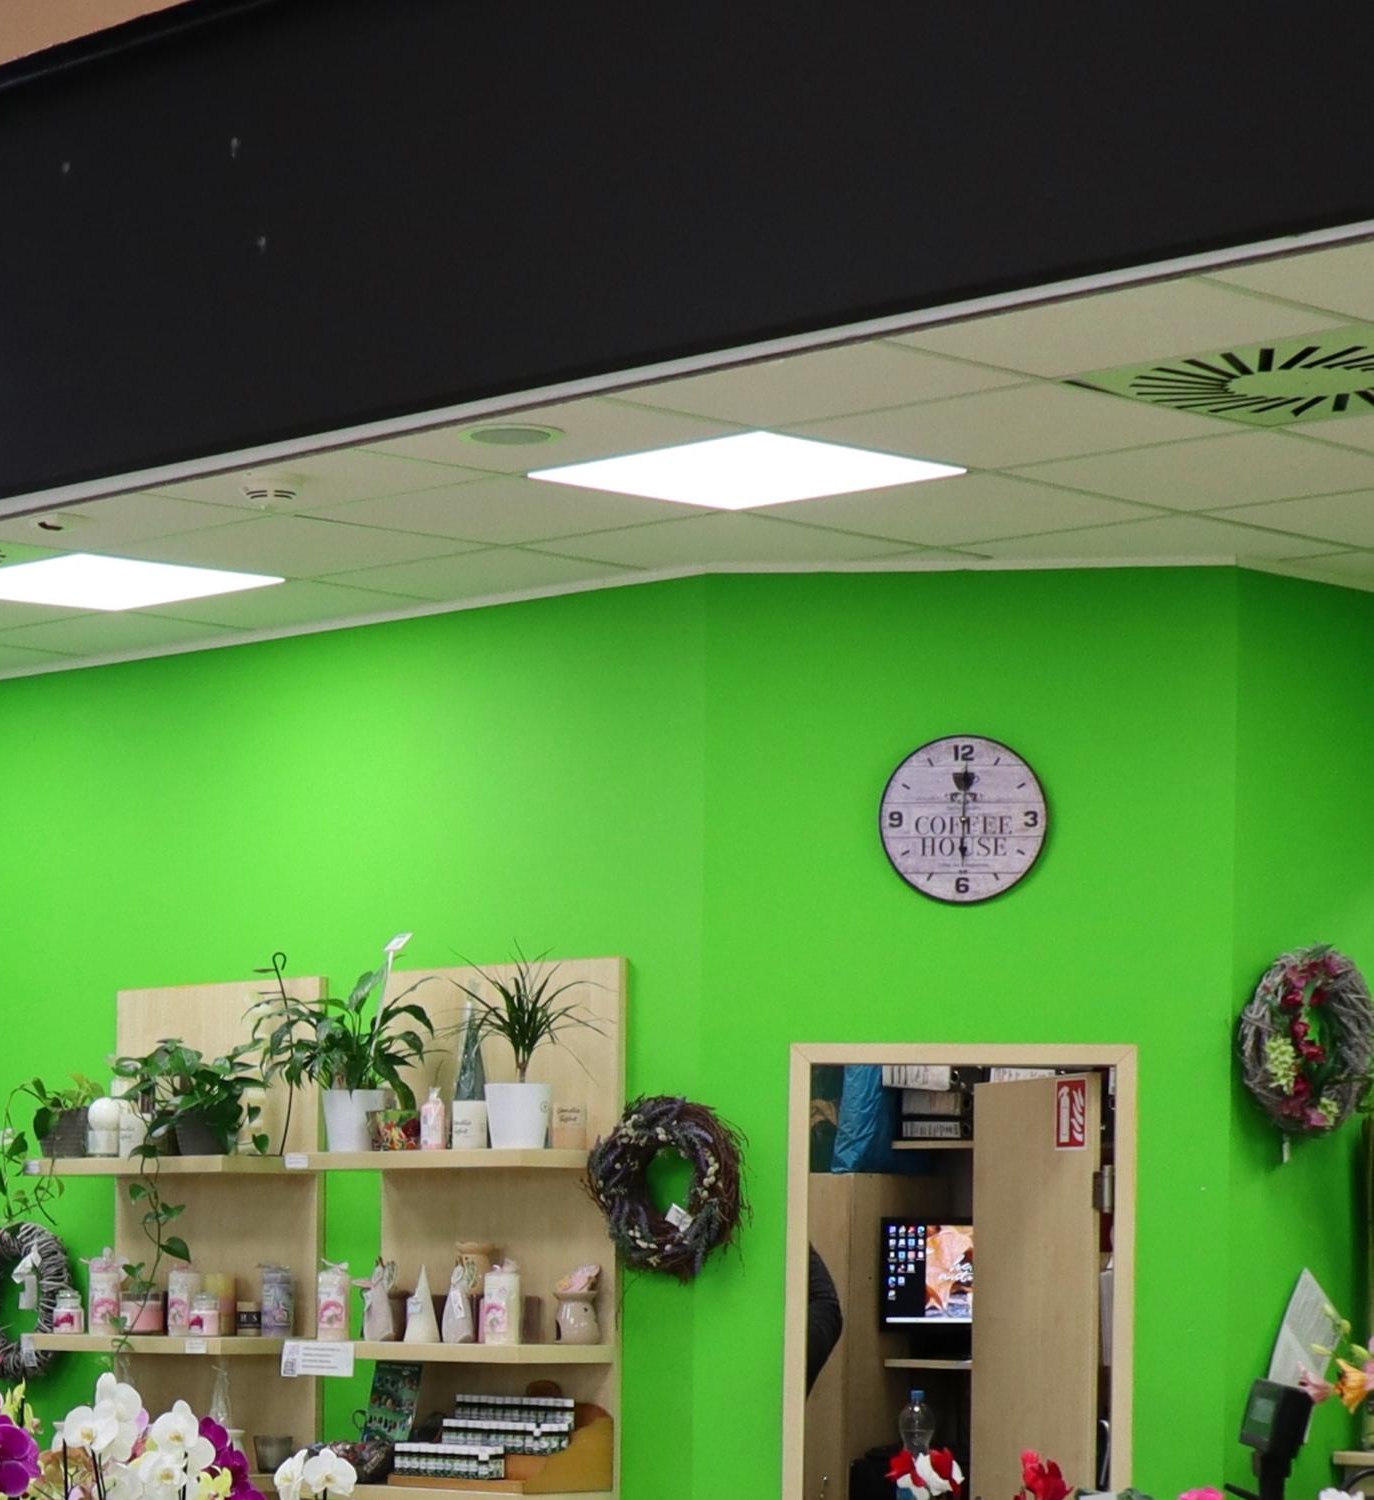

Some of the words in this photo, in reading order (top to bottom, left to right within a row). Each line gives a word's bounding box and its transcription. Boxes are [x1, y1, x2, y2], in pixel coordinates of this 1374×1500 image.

[953, 744, 975, 762] 12
[888, 811, 903, 828] 9
[914, 815, 1013, 836] COFFEE
[1024, 810, 1038, 828] 3
[921, 836, 1008, 858] HOUSE
[955, 877, 970, 894] 6
